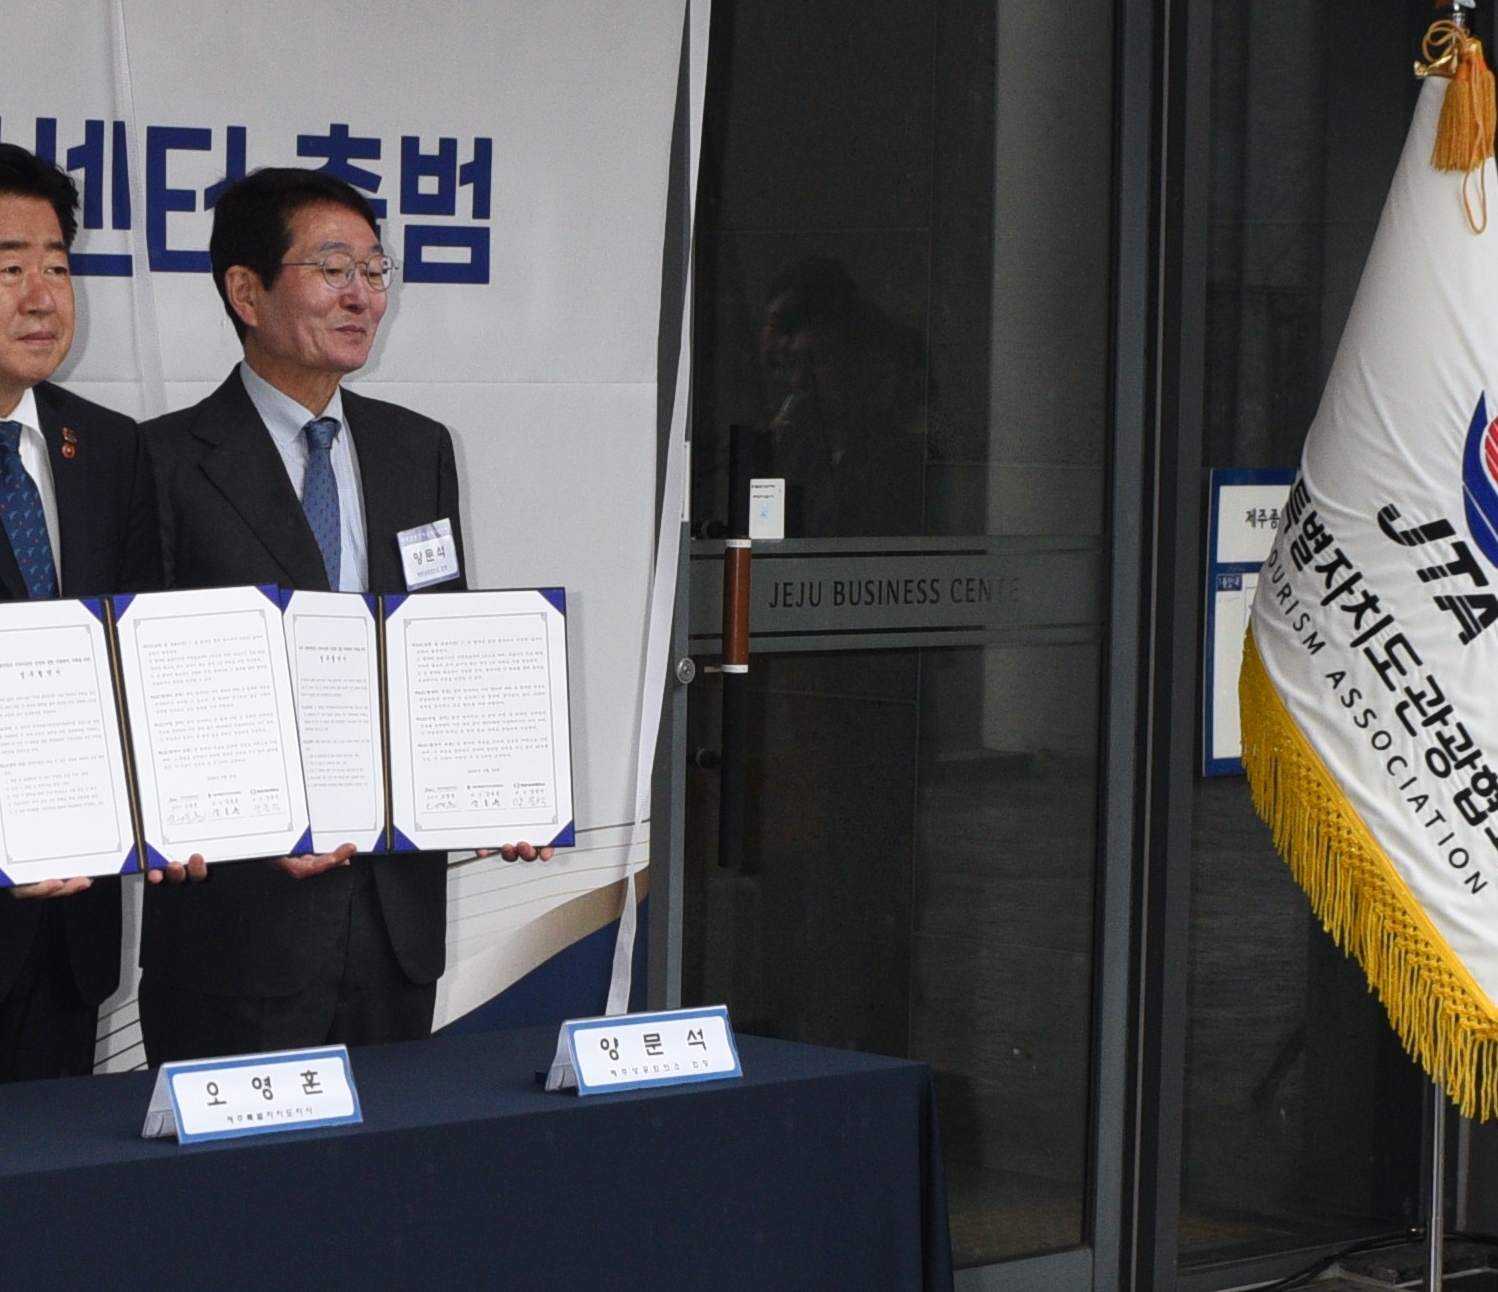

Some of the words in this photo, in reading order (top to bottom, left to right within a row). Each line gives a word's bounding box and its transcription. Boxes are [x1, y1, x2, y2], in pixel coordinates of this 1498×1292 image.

[769, 581, 822, 608] JEJU
[833, 578, 940, 607] BUSINESS
[1325, 670, 1488, 894] ASSOCIATION
